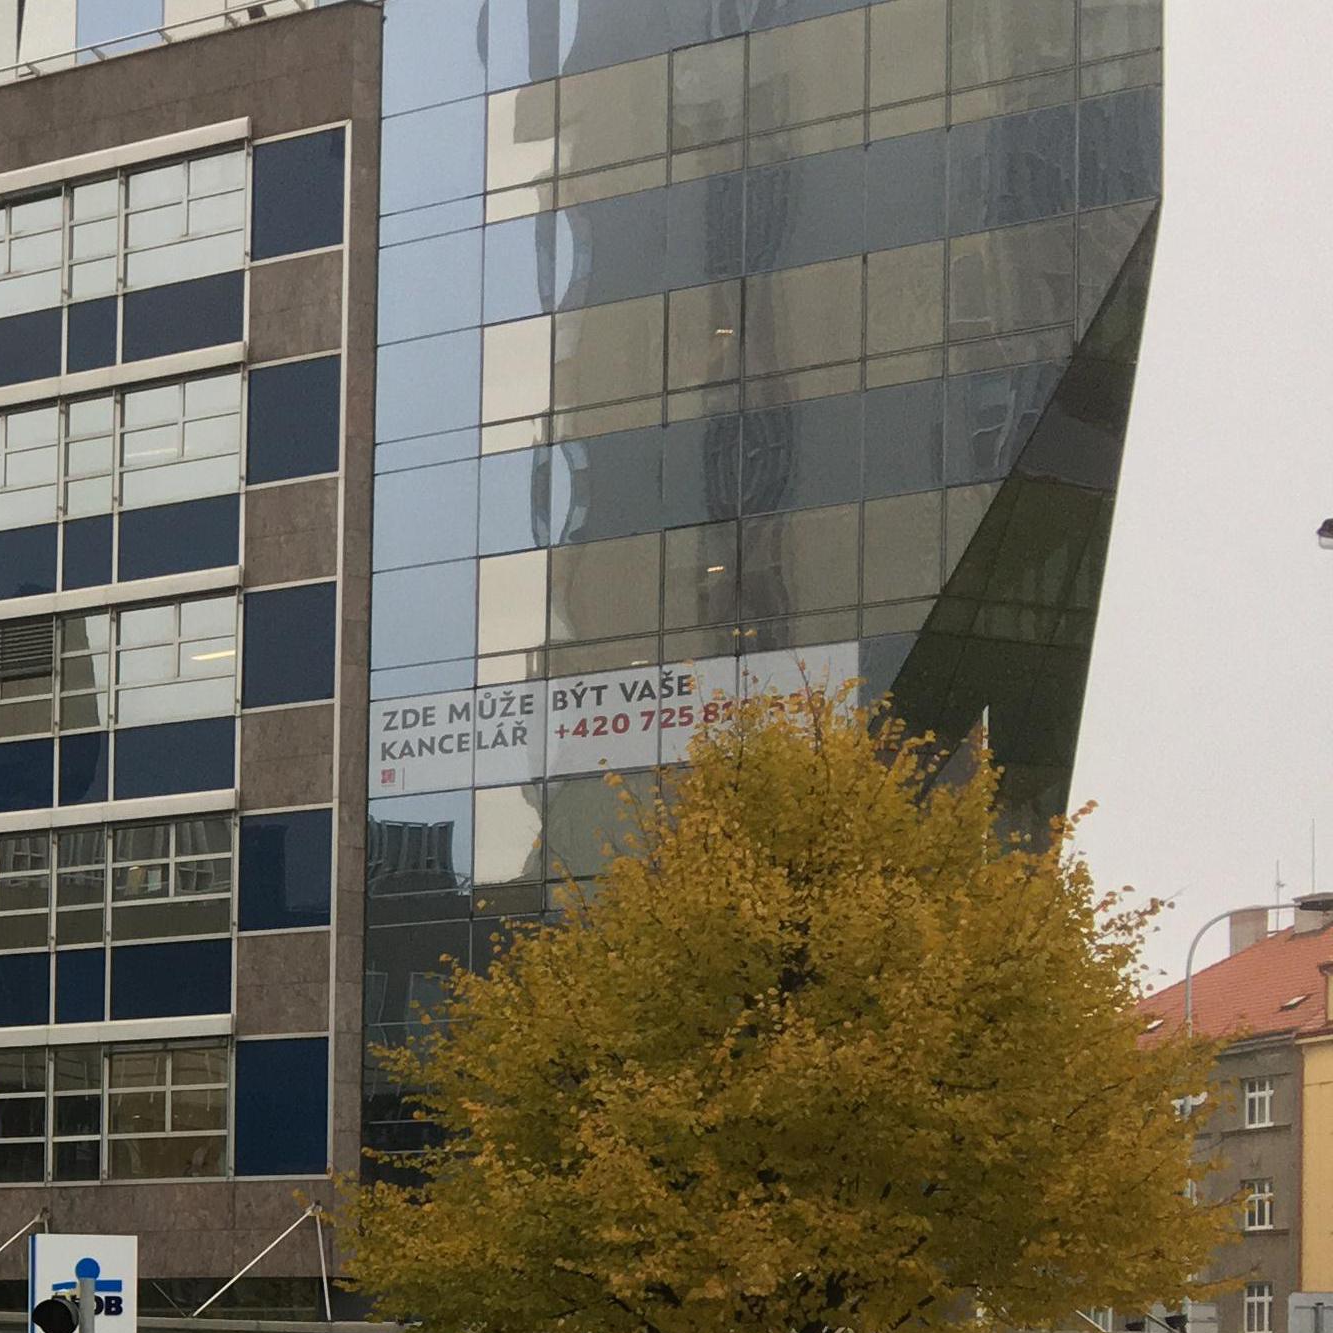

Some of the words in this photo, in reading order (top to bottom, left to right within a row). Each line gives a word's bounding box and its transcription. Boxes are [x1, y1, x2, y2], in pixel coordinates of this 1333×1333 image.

[382, 706, 436, 731] ZDE
[448, 690, 533, 723] MŮŽE
[552, 681, 607, 711] BÝT
[619, 670, 694, 702] VAŠE
[381, 720, 528, 761] KANCELÁŘ
[555, 712, 630, 739] +420
[640, 705, 694, 731] 725
